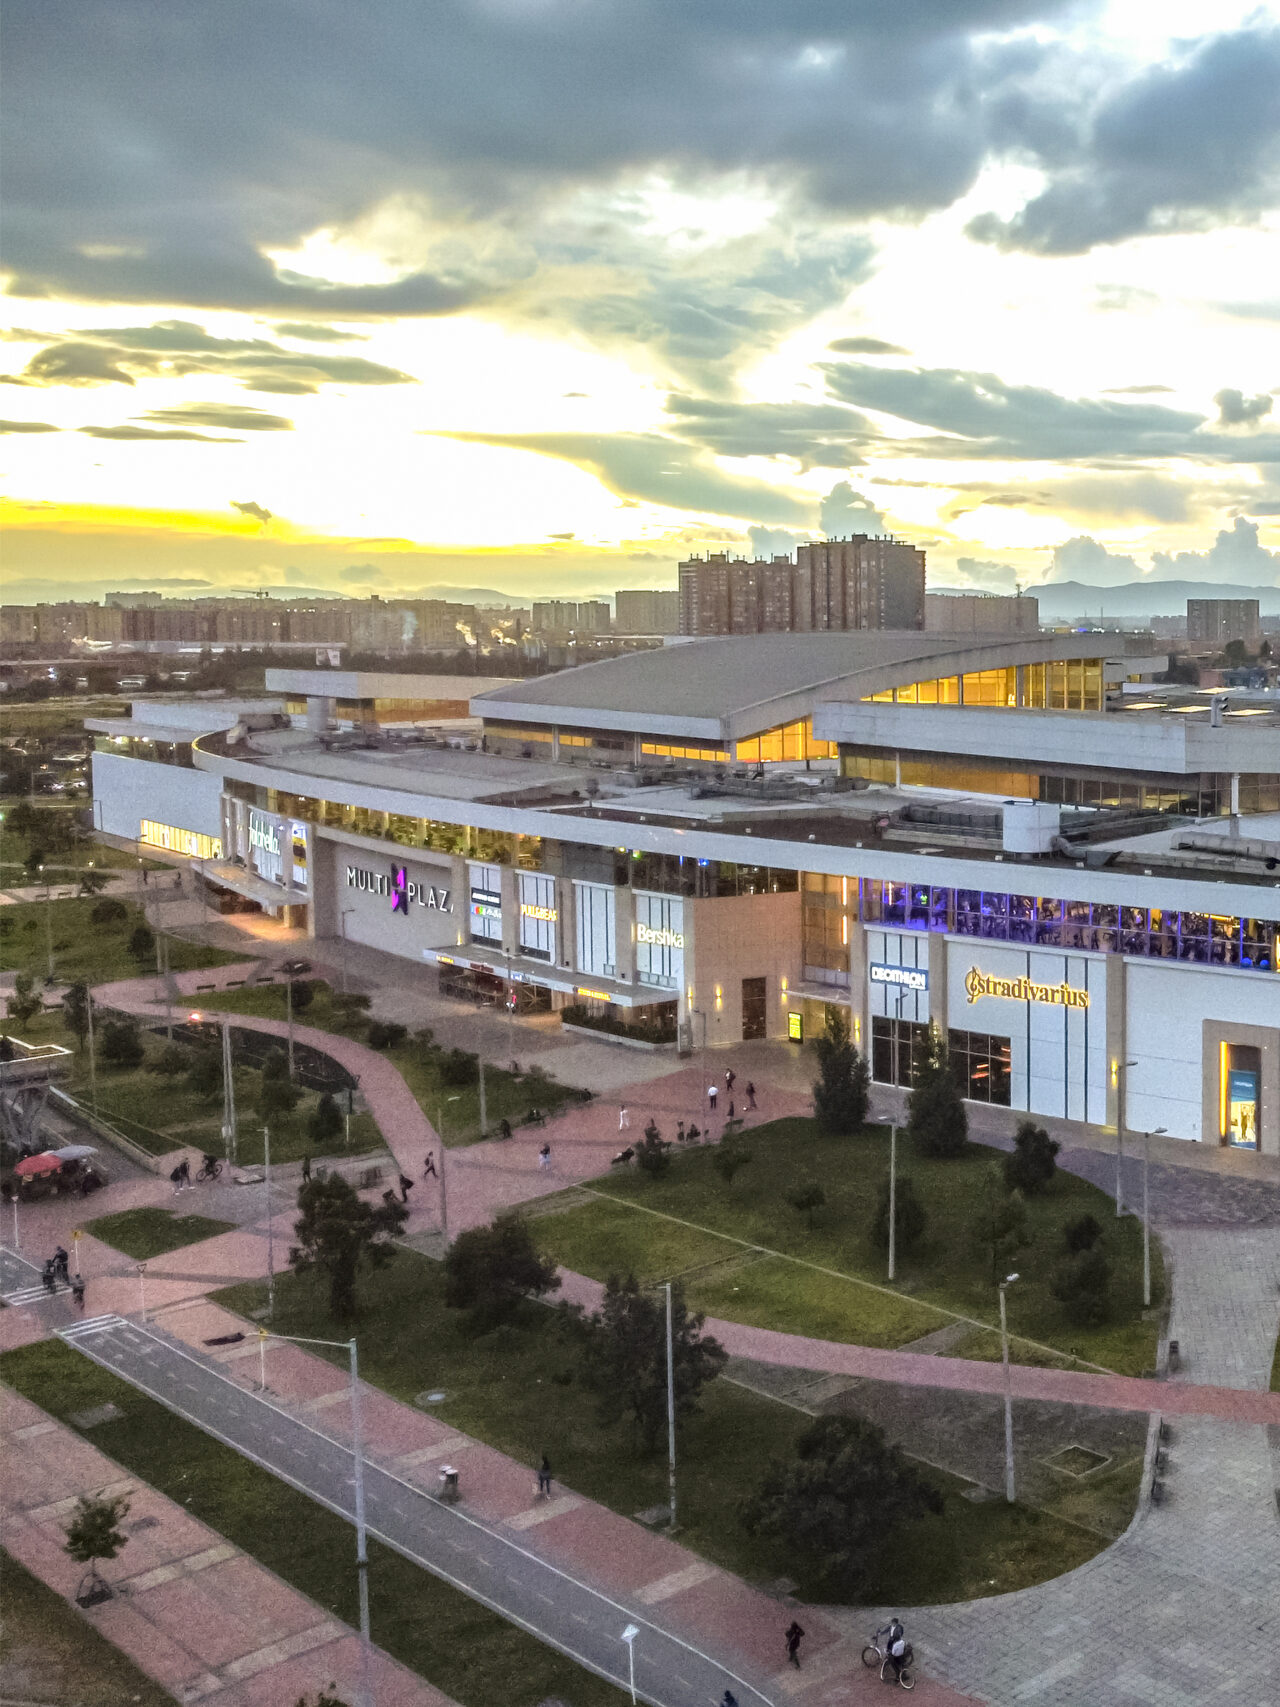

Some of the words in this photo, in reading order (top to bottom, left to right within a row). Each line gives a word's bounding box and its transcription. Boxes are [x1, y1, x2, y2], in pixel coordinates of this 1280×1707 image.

[346, 865, 390, 897] MULTI
[407, 881, 455, 914] PLAZ
[637, 922, 685, 949] Bershka
